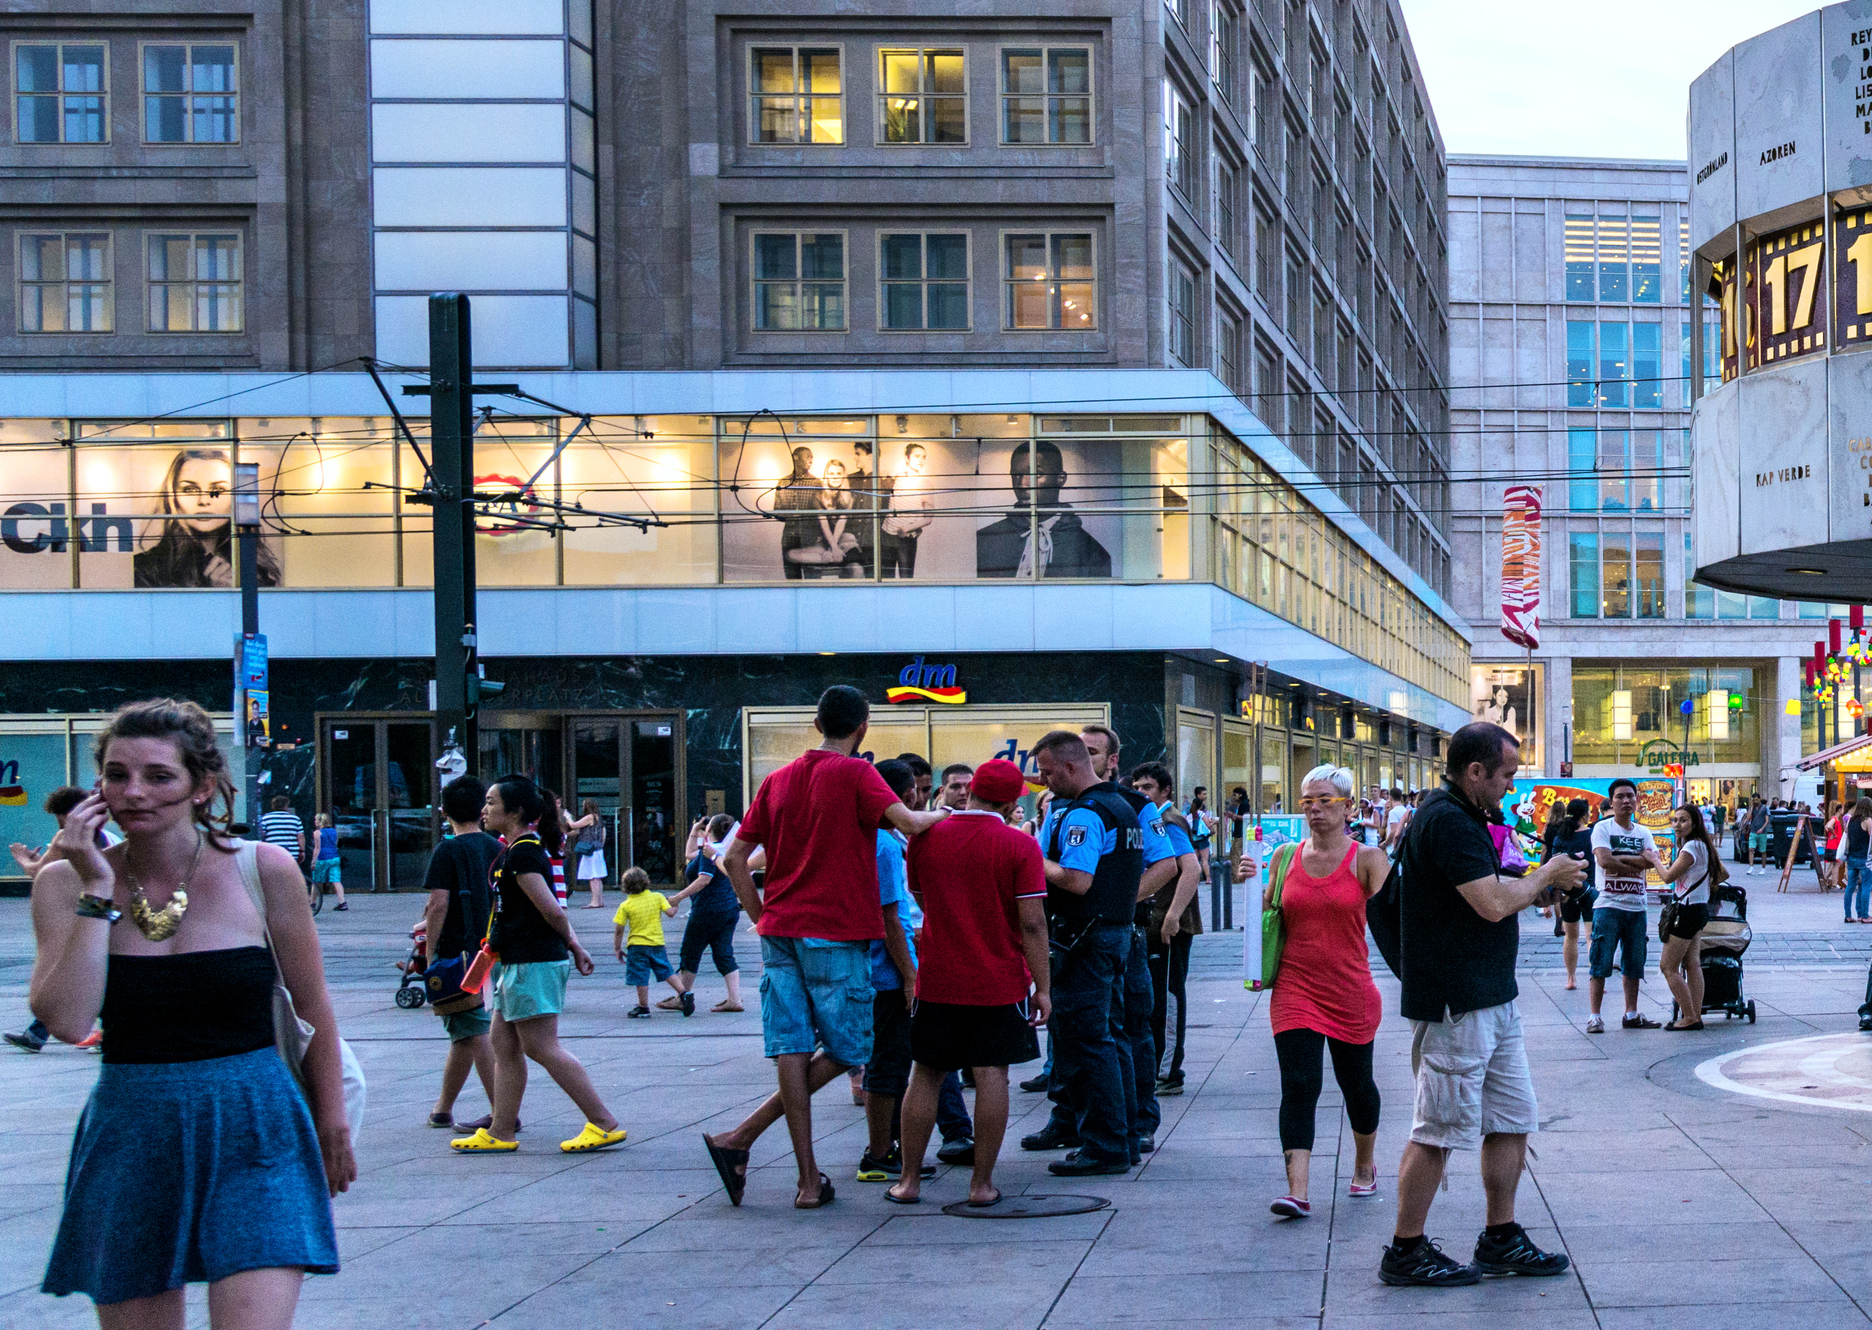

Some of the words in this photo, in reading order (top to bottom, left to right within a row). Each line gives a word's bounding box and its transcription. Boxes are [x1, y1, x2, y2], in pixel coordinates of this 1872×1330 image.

[1760, 140, 1796, 166] AZOREN
[1764, 242, 1825, 336] 17
[1756, 472, 1774, 487] KAP
[1777, 464, 1811, 484] VERDE
[900, 655, 957, 686] dm
[1648, 751, 1699, 766] GALERIA
